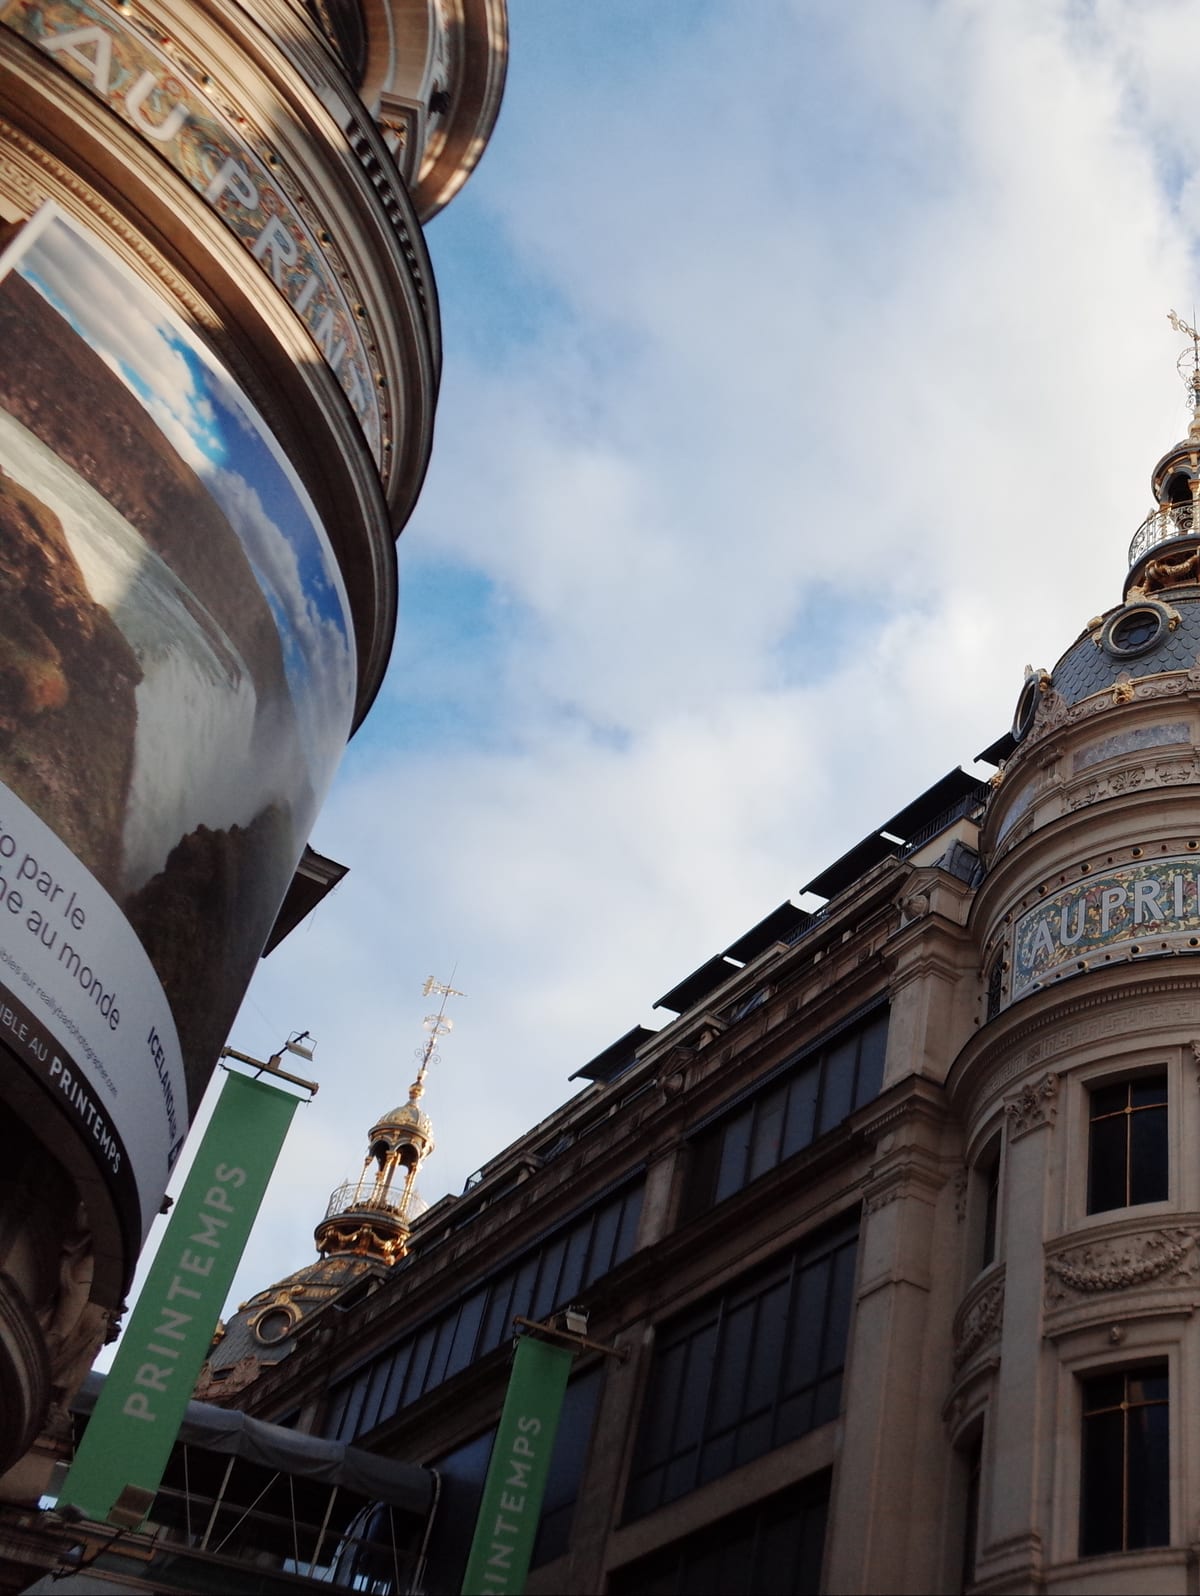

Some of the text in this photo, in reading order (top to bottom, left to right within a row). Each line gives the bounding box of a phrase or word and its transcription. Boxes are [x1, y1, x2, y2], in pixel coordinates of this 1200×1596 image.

[39, 25, 190, 142] AU
[16, 853, 65, 903] par
[64, 892, 86, 930] le
[1028, 898, 1086, 968] AU
[26, 910, 57, 949] au
[58, 942, 120, 1031] monde
[28, 1037, 48, 1061] AU
[49, 1056, 120, 1174] PRINTEMPS
[122, 1161, 247, 1424] PRINTEMPS
[480, 1415, 541, 1596] INTEMPS
